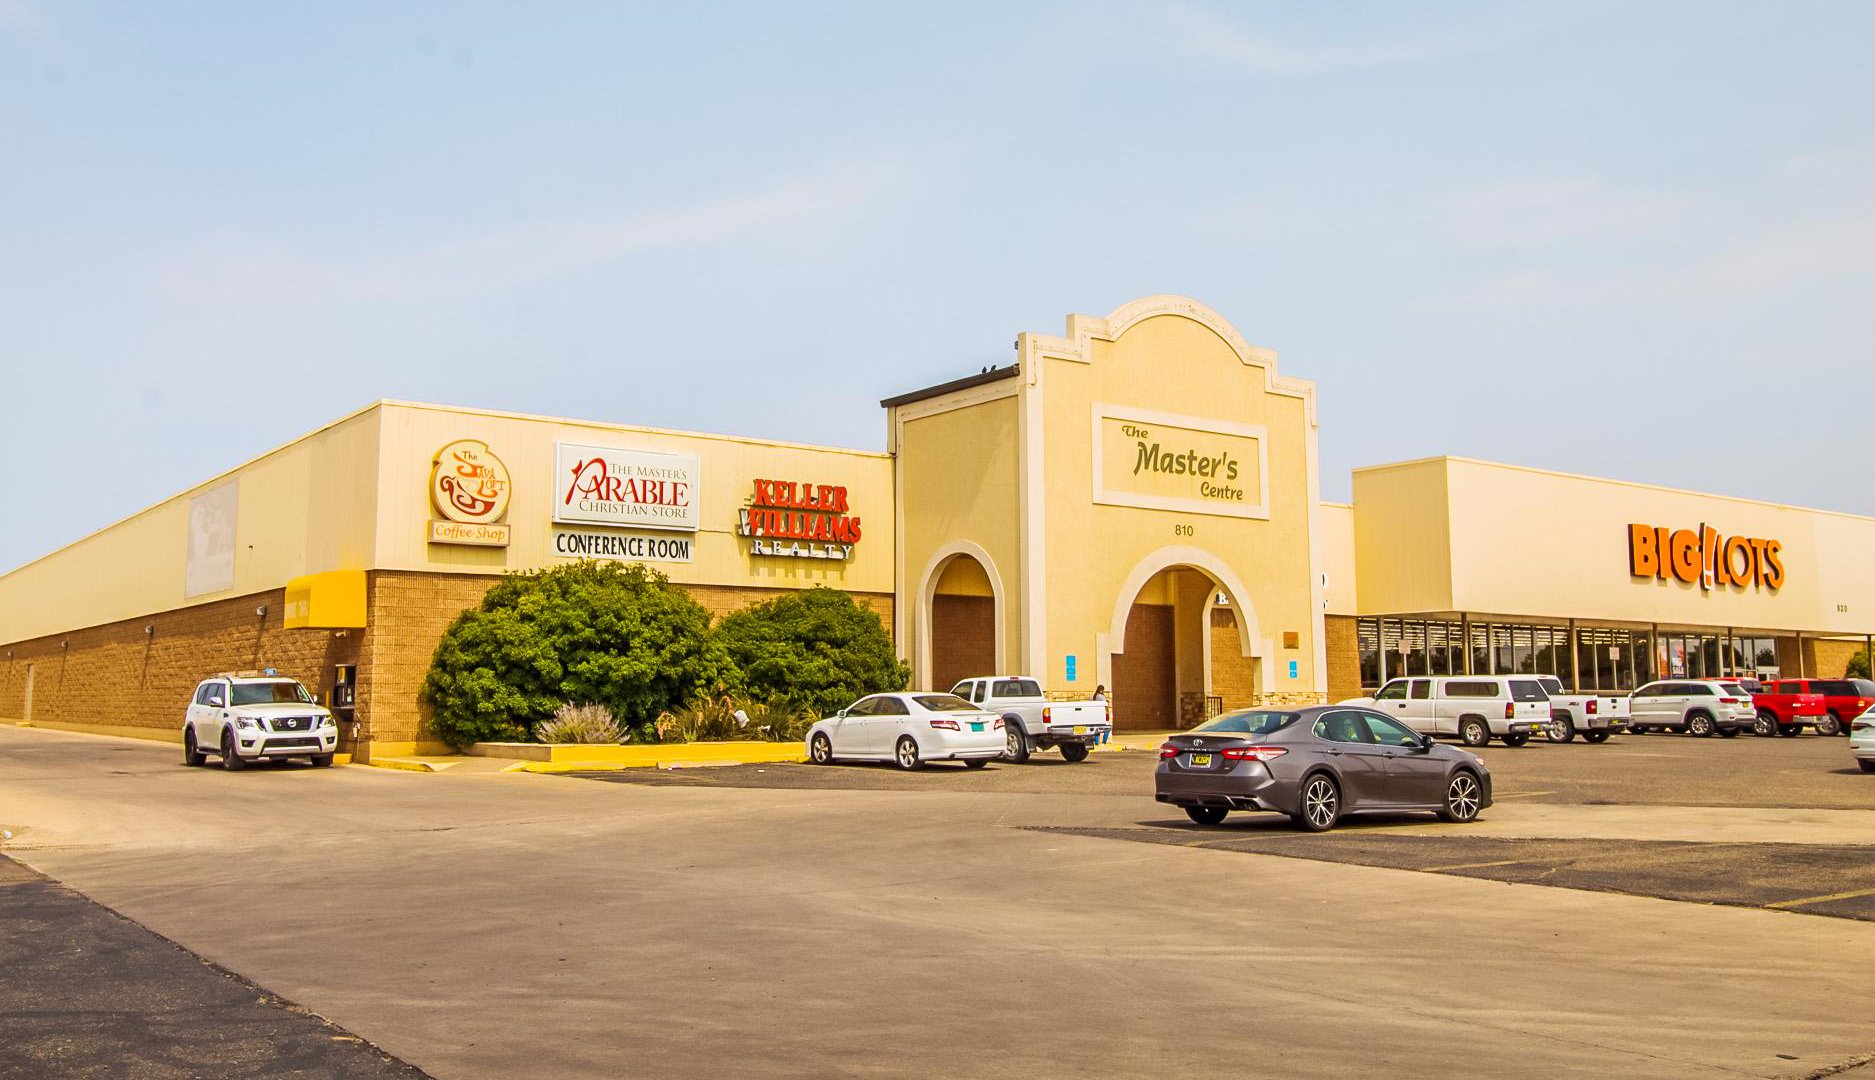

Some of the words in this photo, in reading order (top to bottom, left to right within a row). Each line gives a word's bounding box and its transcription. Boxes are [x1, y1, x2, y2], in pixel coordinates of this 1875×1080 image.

[1122, 425, 1149, 439] The
[461, 450, 478, 460] The
[1133, 441, 1238, 481] Master's
[609, 463, 632, 475] THE
[637, 464, 687, 479] MASTER'S
[565, 457, 689, 507] PARABLE
[1200, 481, 1243, 501] Centre
[753, 478, 849, 513] KELLER
[579, 500, 648, 515] CHRISTIAN
[652, 506, 688, 518] STORE
[435, 525, 473, 539] Coffee
[475, 526, 506, 542] Shop
[738, 508, 862, 544] WILLIAMS
[1174, 524, 1194, 537] 810
[556, 533, 644, 556] CONFERENCE
[648, 538, 689, 560] ROOM
[752, 540, 853, 560] REALTY
